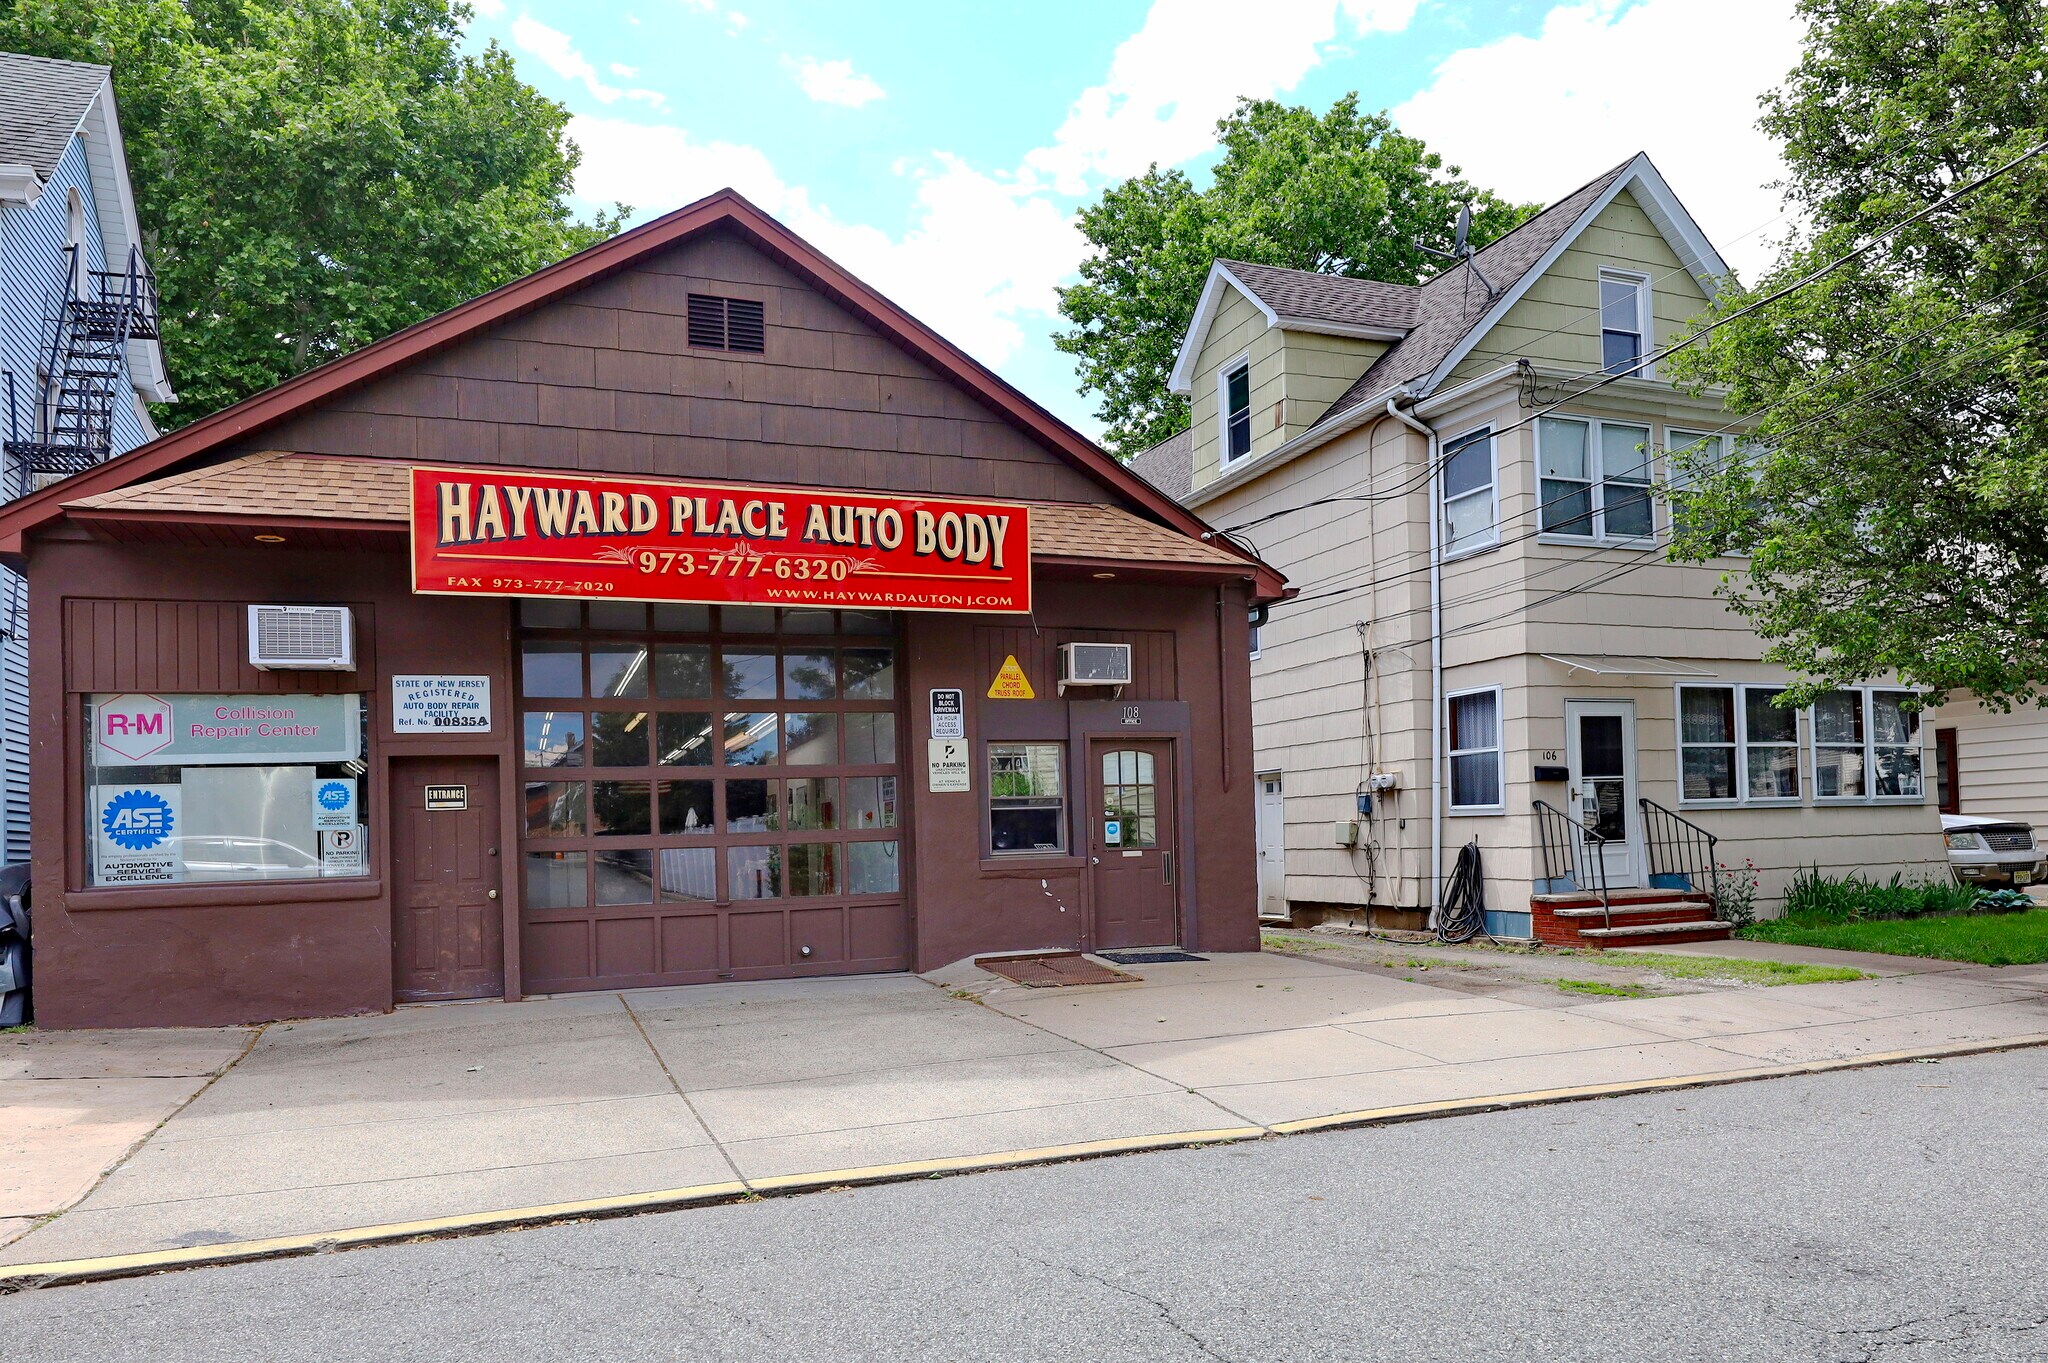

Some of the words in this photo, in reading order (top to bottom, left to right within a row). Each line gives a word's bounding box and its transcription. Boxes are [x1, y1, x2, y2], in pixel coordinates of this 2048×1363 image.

[437, 482, 657, 546] HAYWARD
[669, 496, 788, 539] PLACE
[802, 504, 904, 549] AUTO
[914, 510, 1010, 568] BODY
[639, 551, 846, 581] 973-777-6320
[447, 576, 482, 588] FAX
[492, 578, 614, 592] 973-777-7020
[395, 680, 420, 688] STATE
[423, 680, 433, 688] OF
[437, 680, 455, 688] NEW
[458, 680, 486, 688] JERSEY
[408, 689, 475, 701] REGISTERED
[215, 706, 295, 720] Collision
[1123, 706, 1139, 718] 108
[107, 713, 163, 735] R-M
[398, 718, 414, 726] Ref.
[417, 718, 431, 726] No.
[434, 717, 489, 726] 00835A
[191, 724, 252, 739] Repair
[258, 723, 319, 737] Center
[1543, 751, 1557, 760] 106
[322, 790, 345, 800] ASE
[428, 790, 464, 799] ENTRANCE
[111, 807, 163, 828] ASE
[105, 861, 173, 869] AUTOMOTIVE
